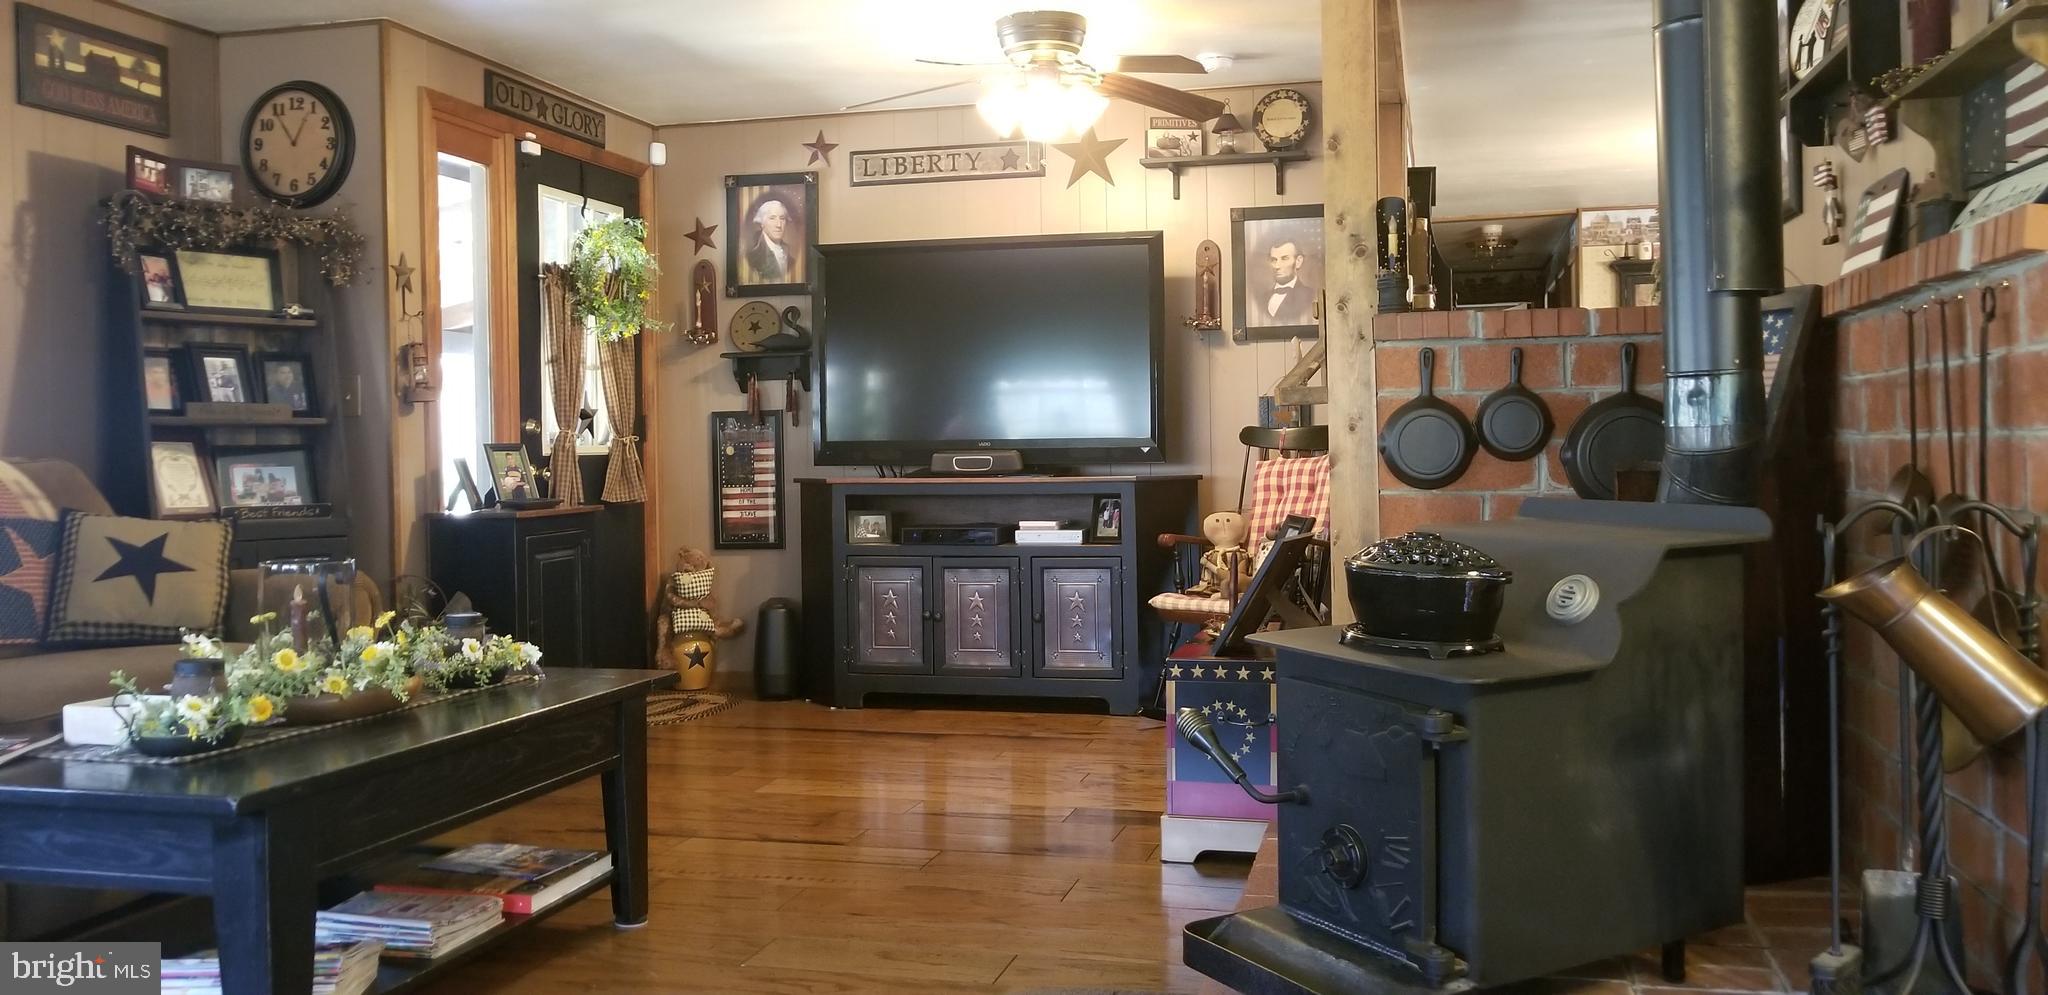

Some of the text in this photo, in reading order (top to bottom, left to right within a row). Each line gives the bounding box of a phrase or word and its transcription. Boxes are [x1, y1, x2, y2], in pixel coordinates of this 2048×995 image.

[41, 78, 157, 124] GOD BLESS AMERICA
[288, 97, 305, 111] 12
[310, 101, 317, 114] 1
[273, 103, 285, 116] 11
[495, 82, 602, 138] OLD GLORY
[260, 118, 274, 131] 10
[321, 116, 330, 130] 2
[1152, 118, 1198, 128] PRIMITIVES
[254, 138, 263, 151] 9
[326, 137, 336, 151] 3
[260, 158, 268, 172] 8
[320, 157, 328, 170] 4
[862, 150, 983, 177] LIBERTY
[272, 173, 281, 186] 7
[289, 179, 299, 193] 6
[307, 172, 316, 186] 5
[240, 506, 315, 519] Best Friends
